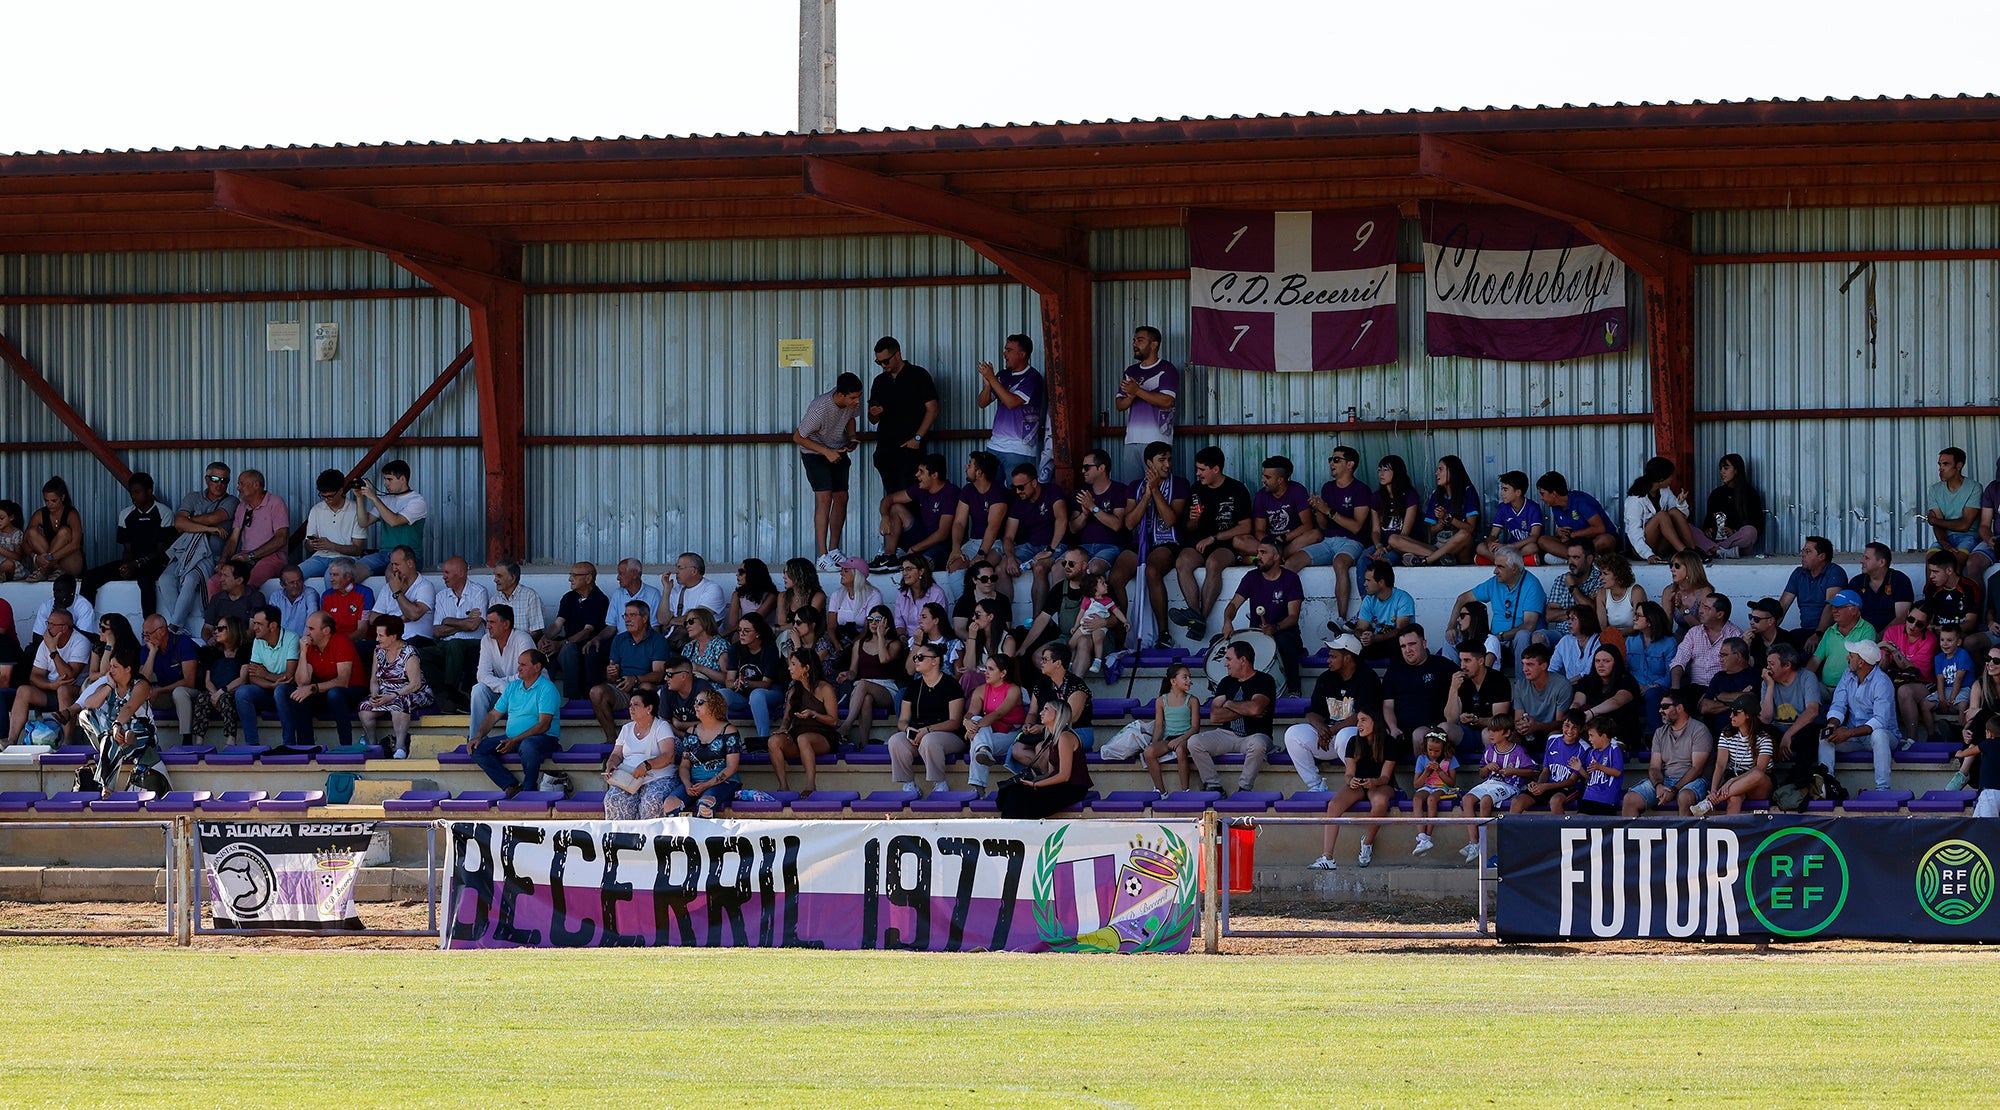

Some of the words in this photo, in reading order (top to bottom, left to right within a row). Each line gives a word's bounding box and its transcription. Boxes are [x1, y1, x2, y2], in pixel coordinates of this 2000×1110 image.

[1224, 225, 1248, 253] 1
[1352, 220, 1375, 252] 9
[1273, 272, 1389, 306] Becerril
[1434, 223, 1614, 340] Chocheboys
[1228, 324, 1250, 352] 7
[200, 824, 221, 837] LA
[226, 824, 293, 837] ALIANZA
[299, 824, 375, 836] REBELDE
[451, 822, 824, 949] BECERRIL
[862, 835, 1025, 951] 1977
